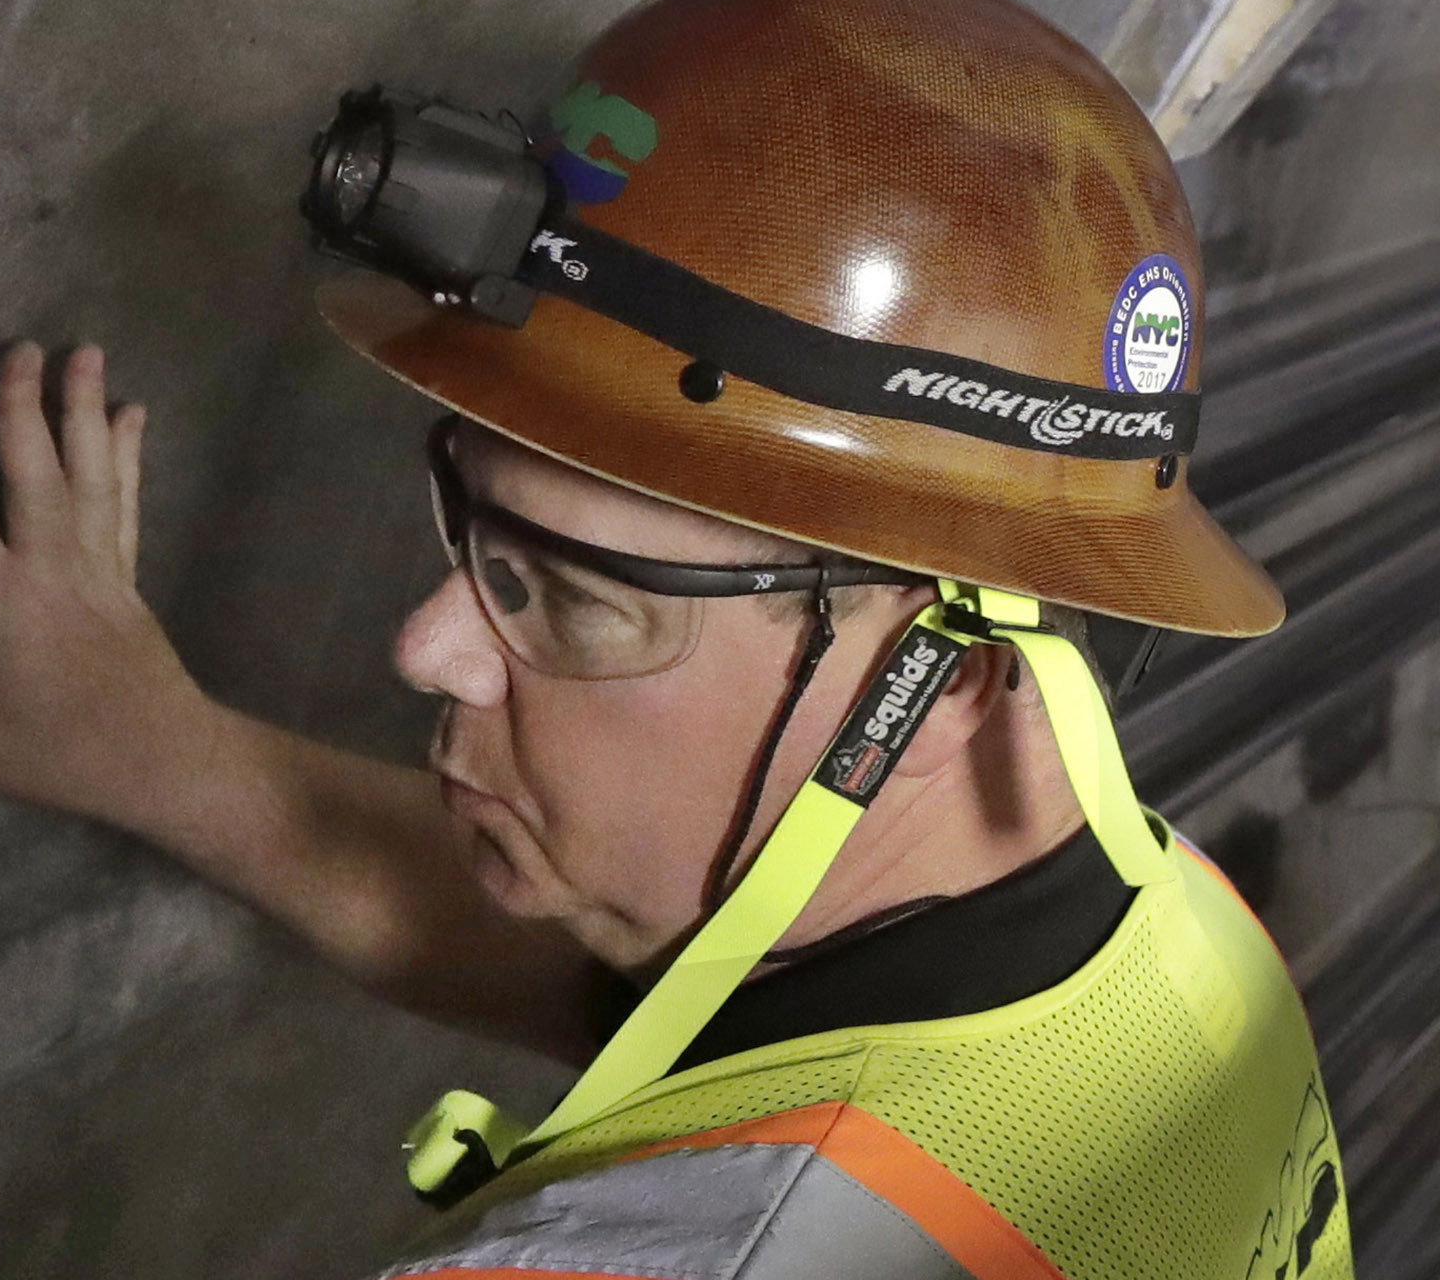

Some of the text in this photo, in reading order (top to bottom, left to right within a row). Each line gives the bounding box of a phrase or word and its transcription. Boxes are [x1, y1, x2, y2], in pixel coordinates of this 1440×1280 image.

[1113, 266, 1190, 342] BEDC EHS Orientation
[1132, 312, 1180, 347] NYC
[1137, 371, 1166, 390] 2017
[753, 573, 776, 591] XP
[864, 646, 939, 741] squids
